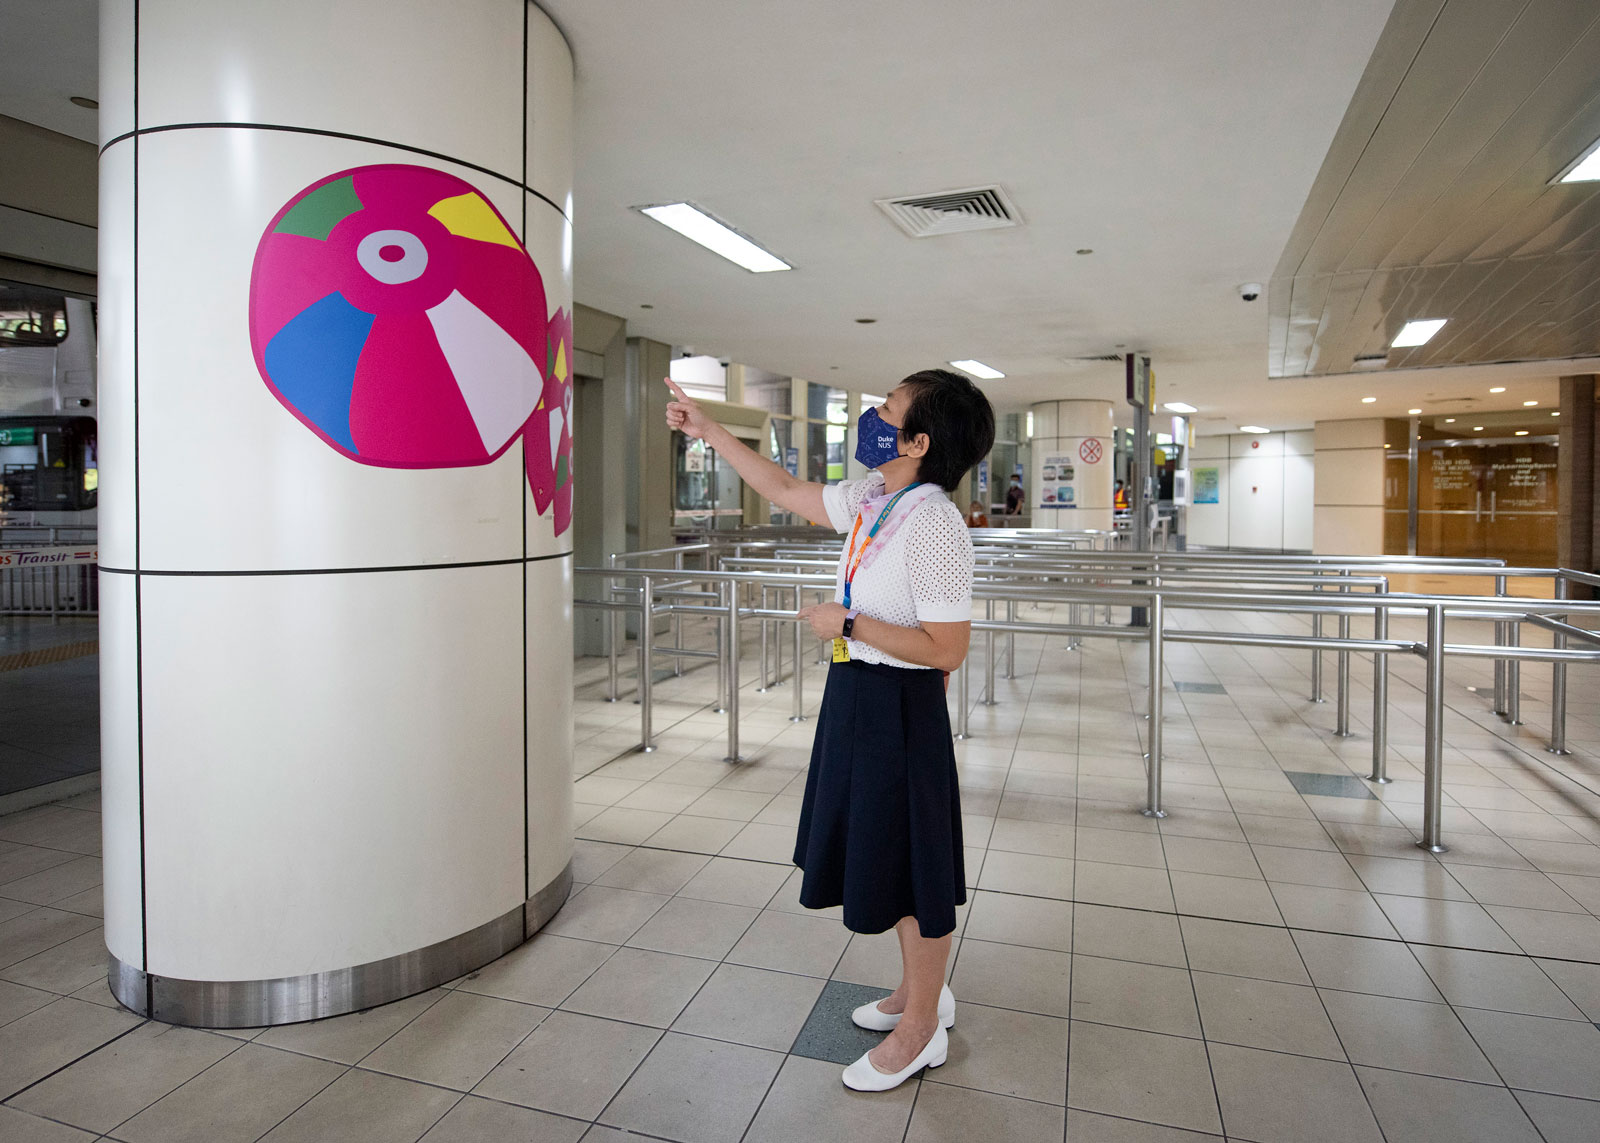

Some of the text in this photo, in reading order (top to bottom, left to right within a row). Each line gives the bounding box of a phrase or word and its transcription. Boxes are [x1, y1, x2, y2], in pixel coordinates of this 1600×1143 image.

[1491, 463, 1557, 471] MyLearningSpace
[1510, 473, 1538, 481] Library
[11, 551, 71, 566] Transit
